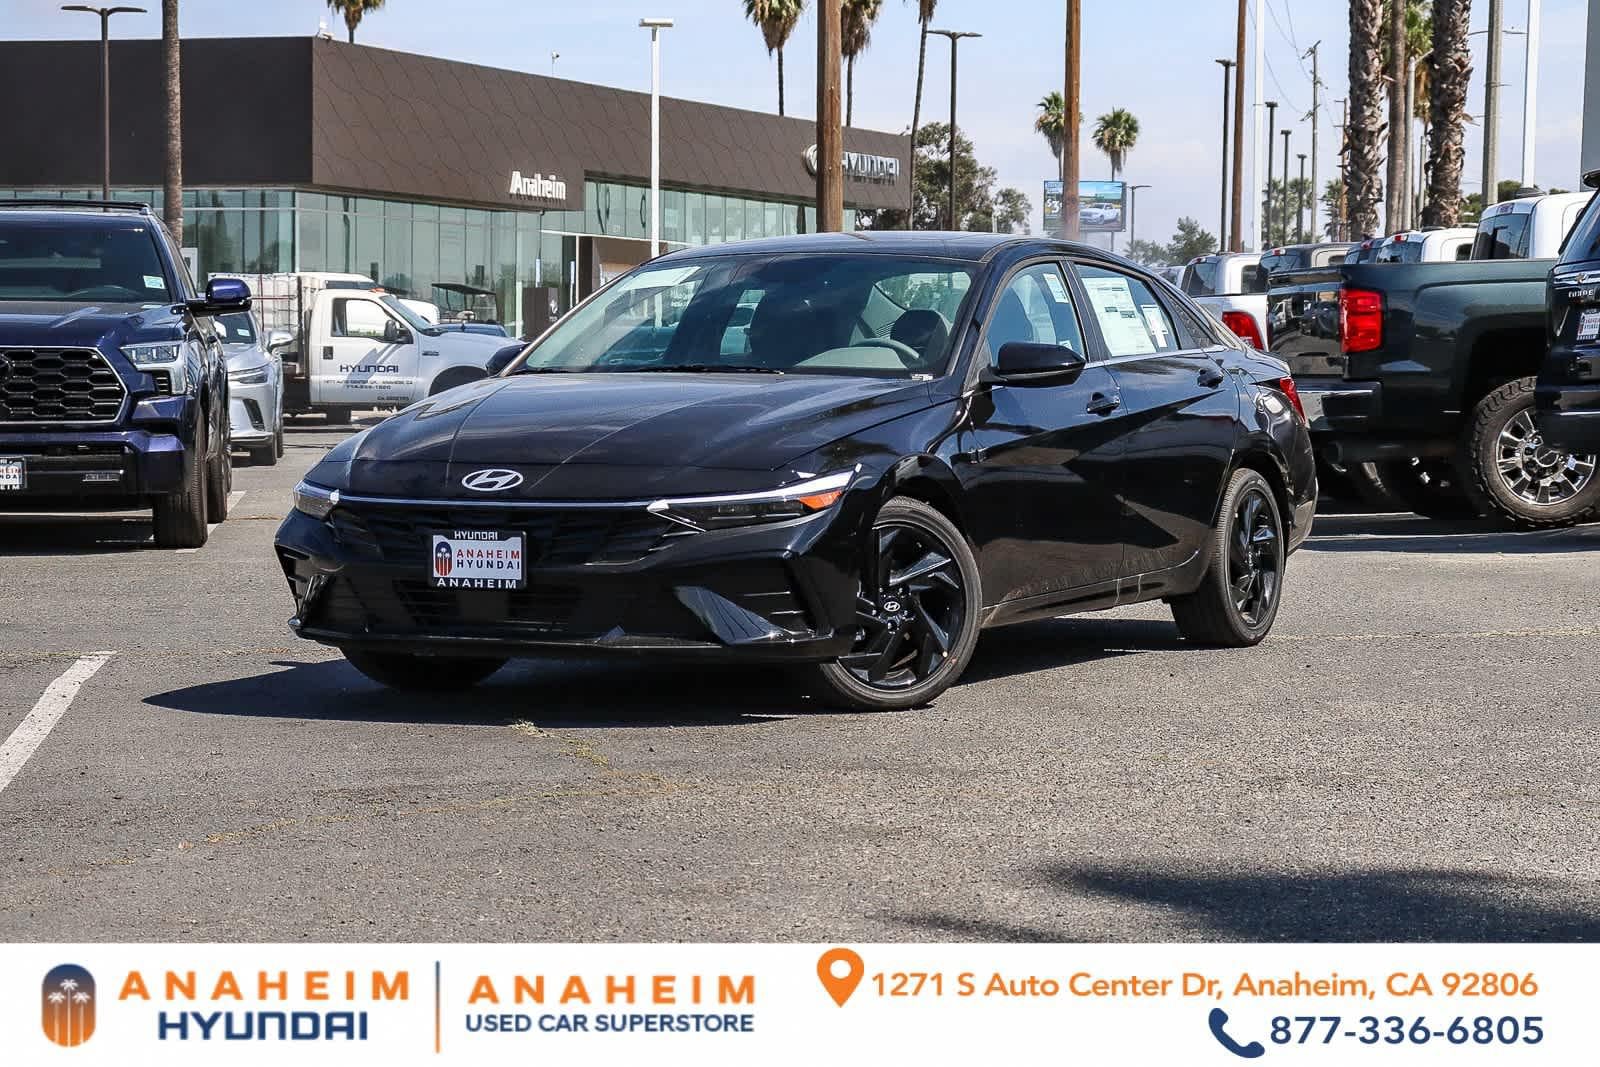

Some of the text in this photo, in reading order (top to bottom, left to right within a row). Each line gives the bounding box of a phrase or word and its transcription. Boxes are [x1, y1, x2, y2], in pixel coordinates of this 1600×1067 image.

[510, 170, 567, 200] Anaheim
[340, 365, 398, 373] HYUNDAI
[454, 531, 498, 540] HYUNDAI
[456, 549, 519, 559] ANAHEIM
[456, 560, 519, 569] HYUNDAI
[437, 578, 516, 589] ANAHEIM
